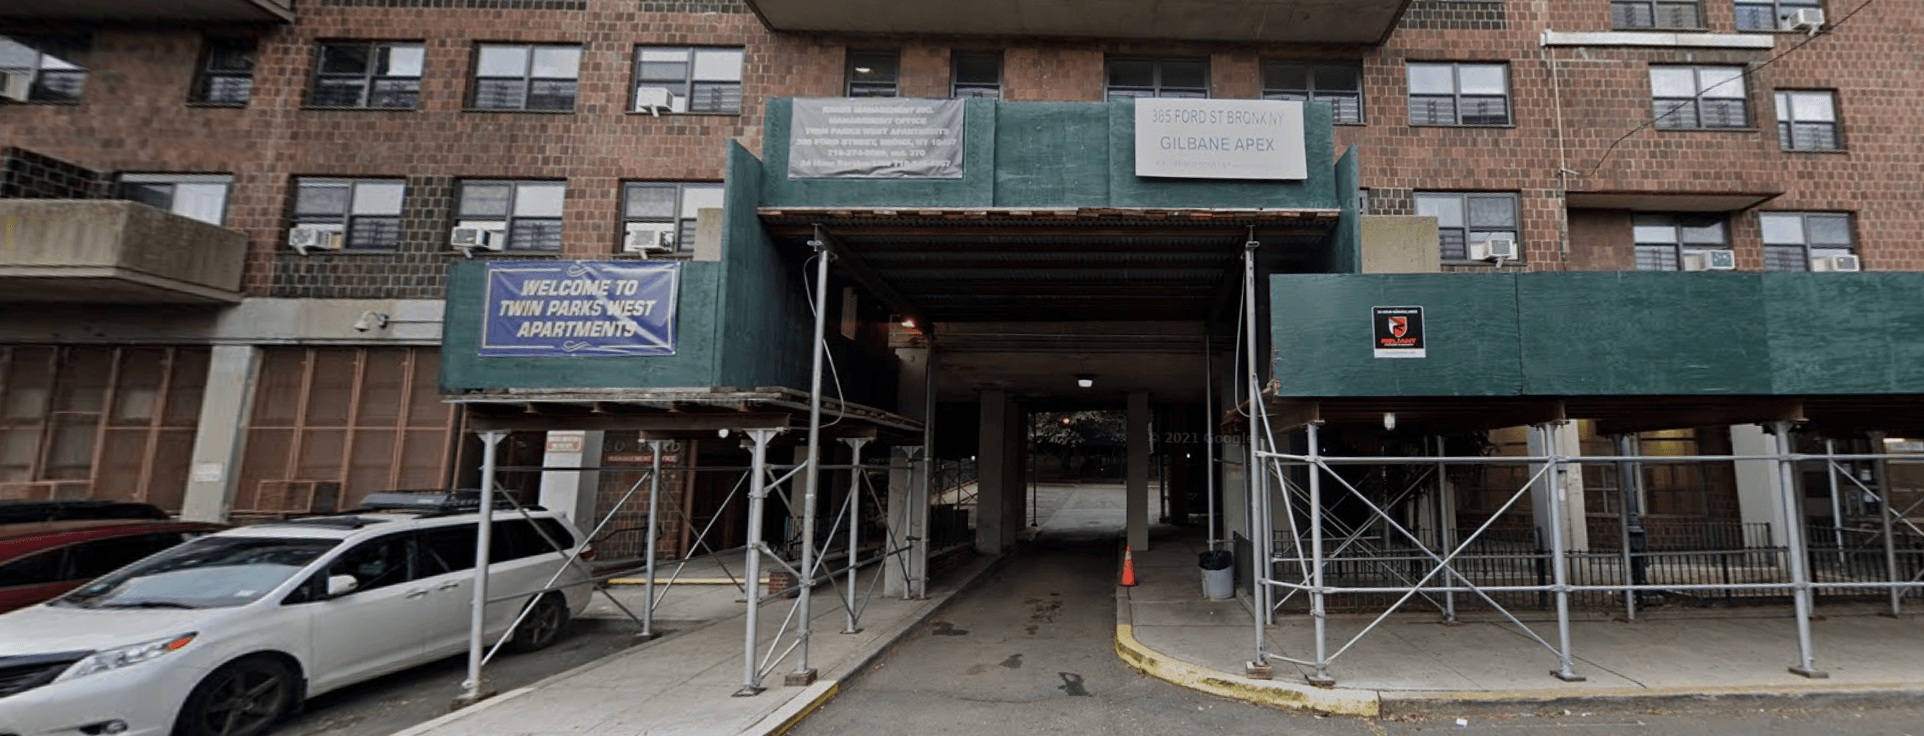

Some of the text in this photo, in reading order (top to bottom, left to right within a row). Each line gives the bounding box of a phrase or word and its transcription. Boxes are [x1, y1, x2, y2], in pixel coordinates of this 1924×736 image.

[1152, 109, 1284, 126] 365 FORD ST BRONX NY
[1160, 136, 1276, 151] GILBANE APEX
[521, 279, 639, 296] WELCOME TO
[499, 299, 658, 317] TWIN PARKS WEST
[517, 320, 637, 338] APARTMENTS
